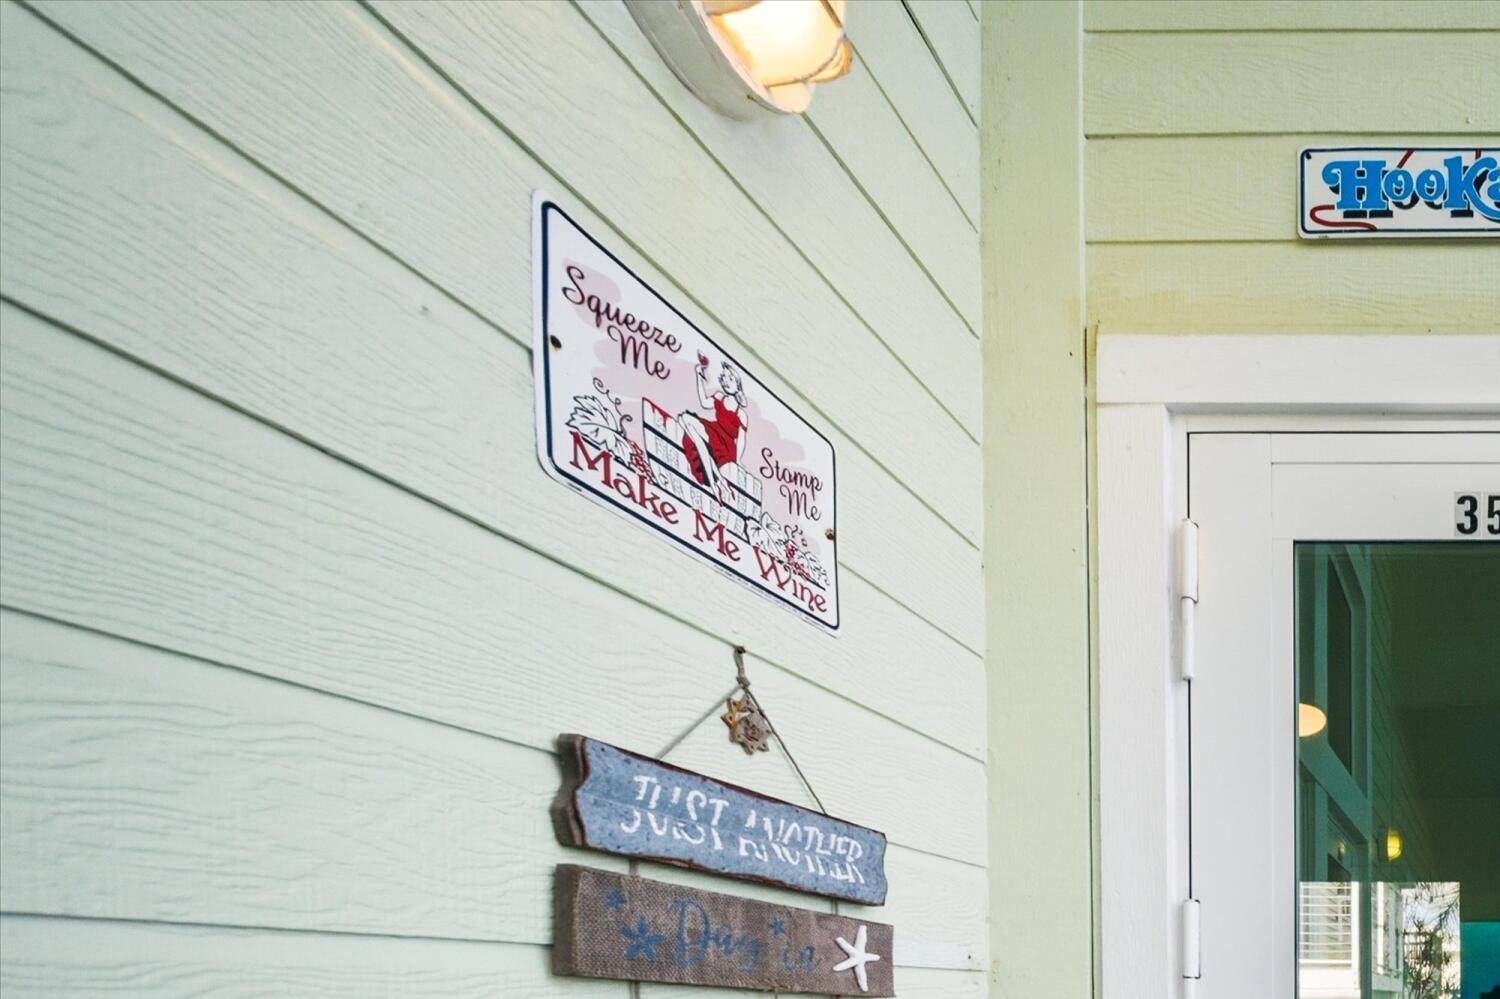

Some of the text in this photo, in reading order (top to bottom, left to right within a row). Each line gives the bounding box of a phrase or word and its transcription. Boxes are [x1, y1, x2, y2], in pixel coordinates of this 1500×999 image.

[561, 266, 682, 353] Squeeze
[607, 325, 671, 381] Me
[569, 432, 679, 525] Make
[692, 509, 741, 562] Me
[752, 546, 828, 613] Wine
[780, 486, 822, 521] Me
